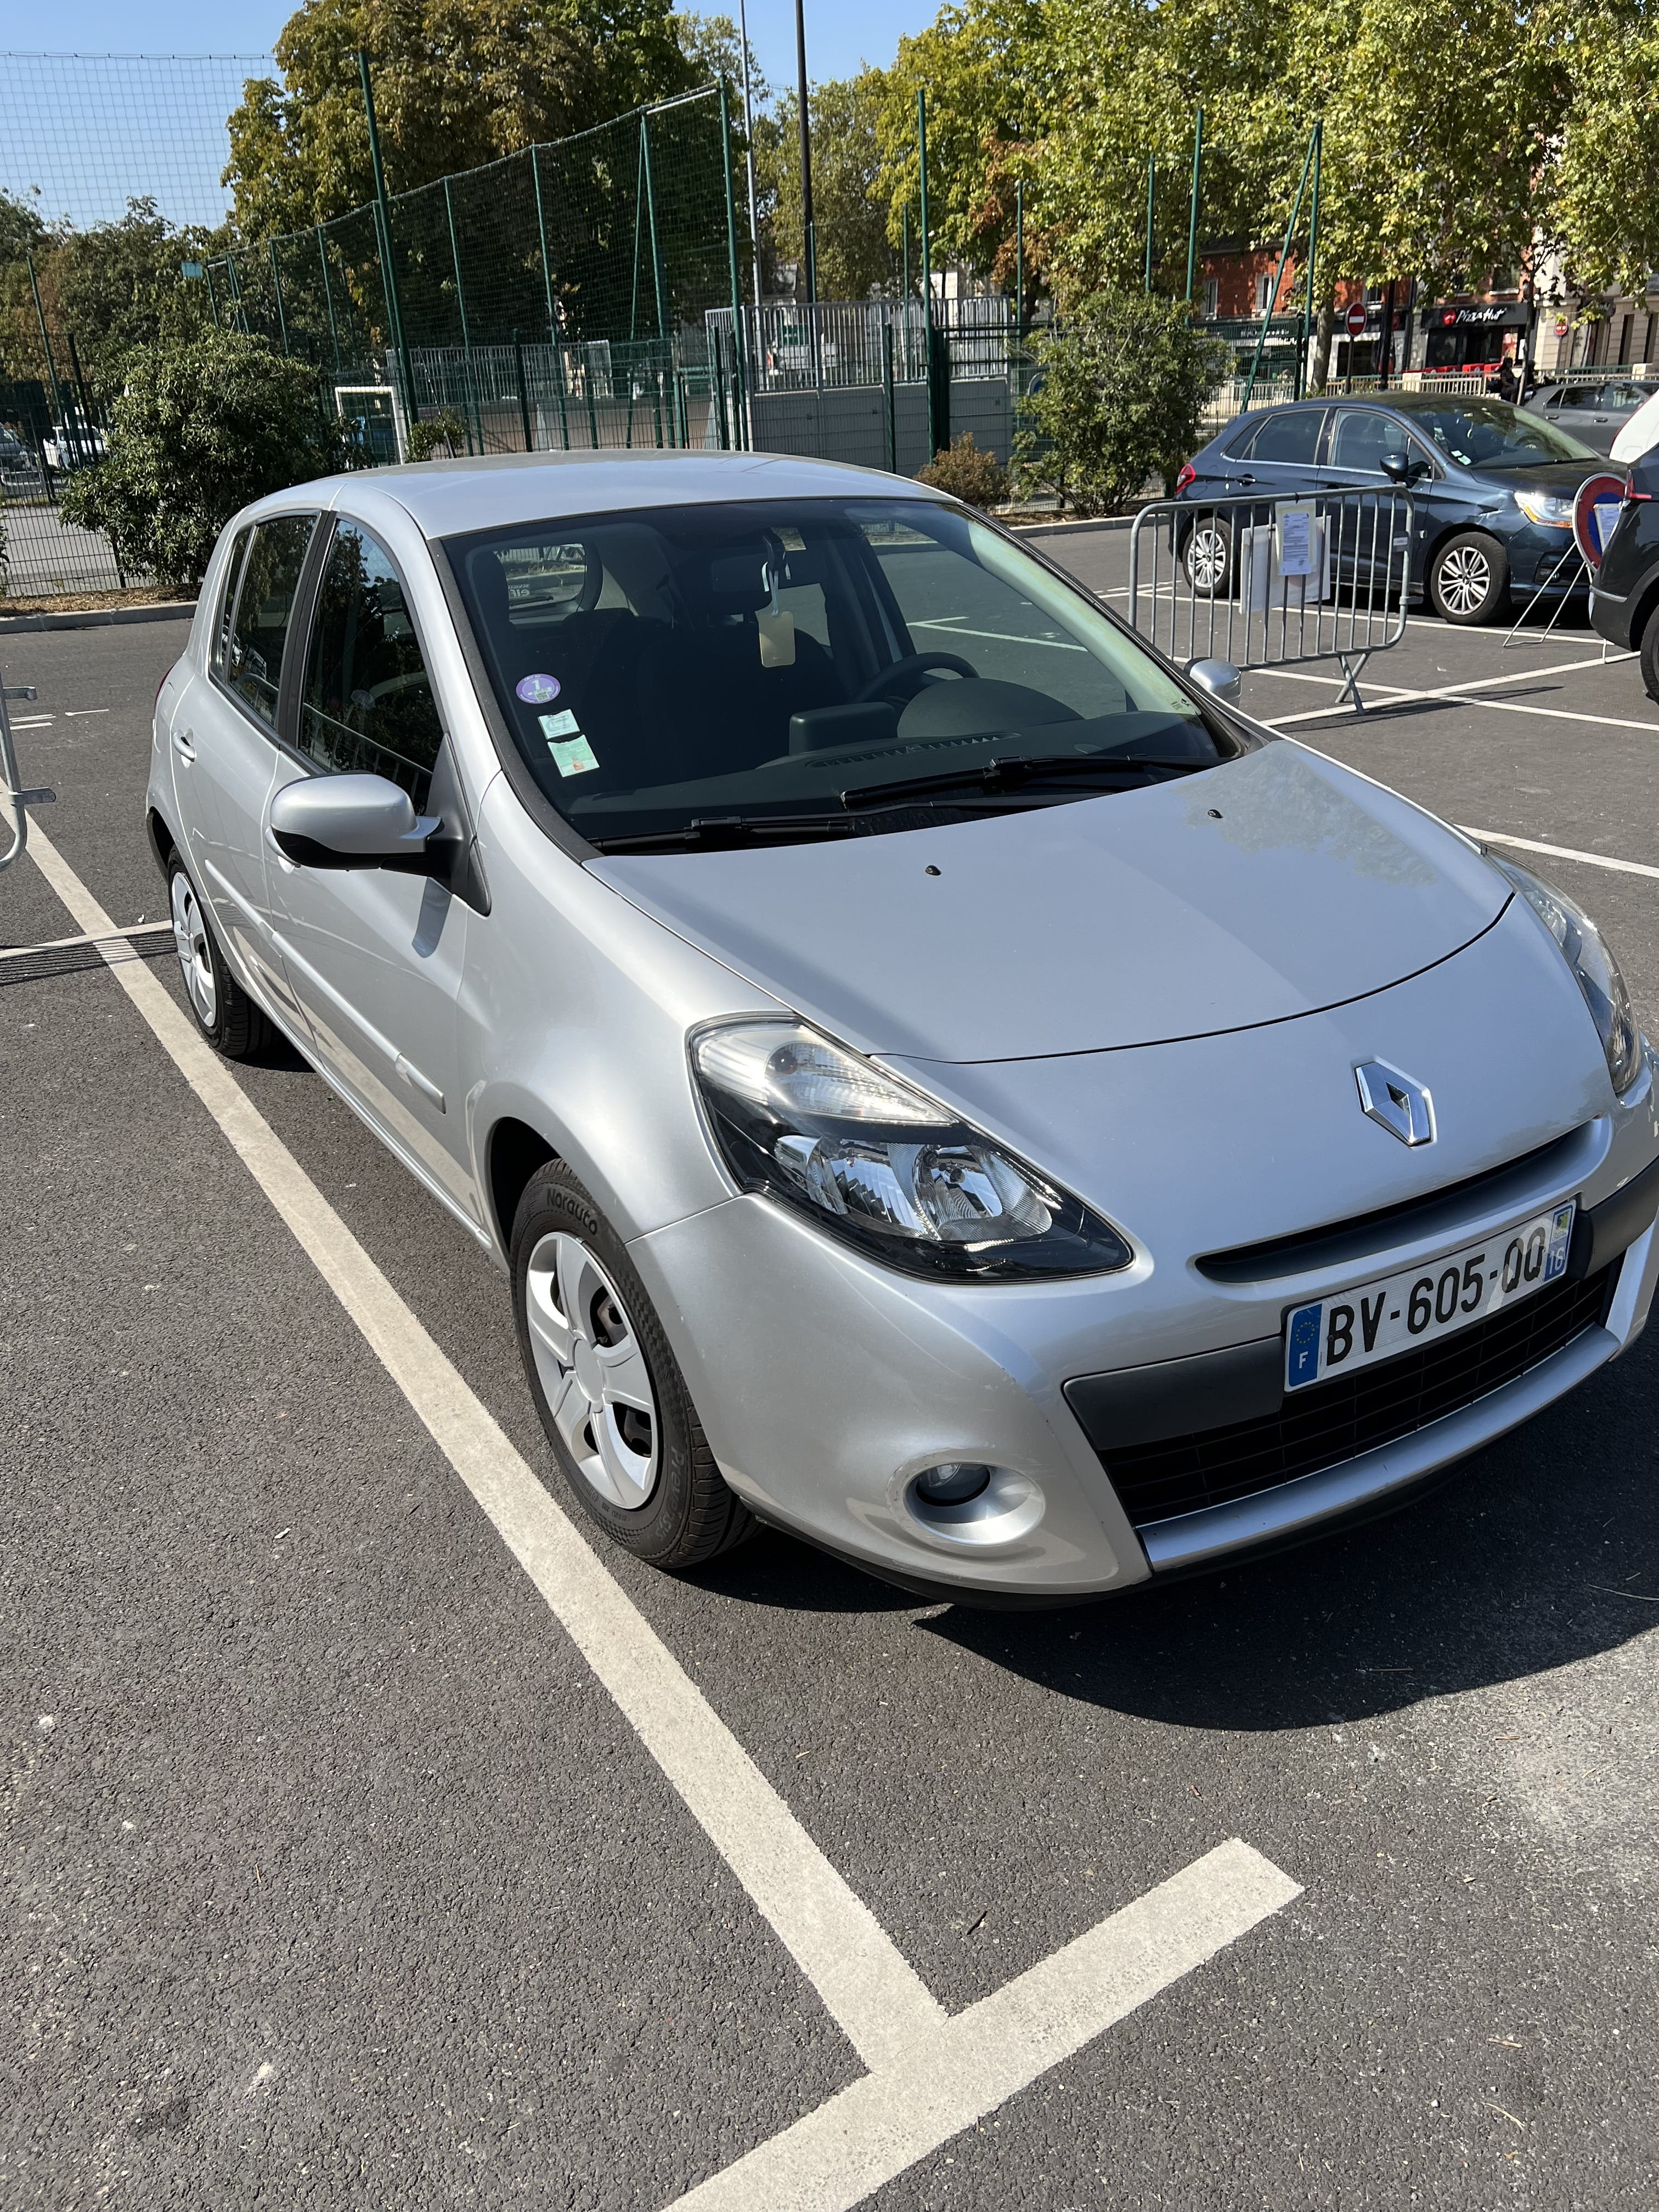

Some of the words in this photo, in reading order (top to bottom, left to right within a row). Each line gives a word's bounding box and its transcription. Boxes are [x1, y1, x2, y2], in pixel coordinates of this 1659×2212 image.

[1455, 309, 1483, 324] Pizza
[1483, 308, 1504, 322] Hut
[532, 679, 540, 690] 1
[546, 1188, 597, 1235] Norauto
[1549, 1246, 1565, 1275] 16
[1326, 1226, 1546, 1366] BV-605-QQ
[1299, 1351, 1308, 1369] F
